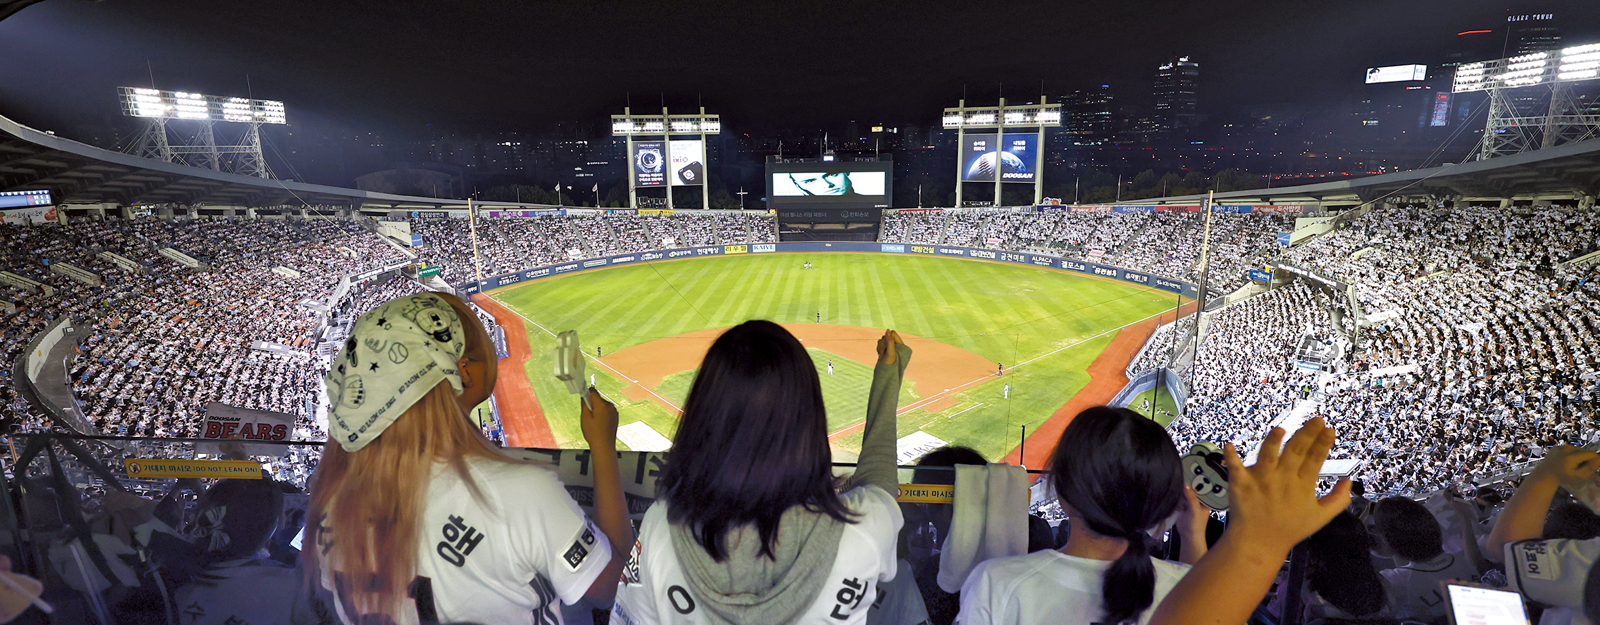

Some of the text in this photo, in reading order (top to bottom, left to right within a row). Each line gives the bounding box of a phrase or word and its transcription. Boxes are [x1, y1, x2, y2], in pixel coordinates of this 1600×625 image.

[204, 422, 288, 440] BEARS
[143, 464, 166, 472] 기대지
[570, 548, 584, 564] EST
